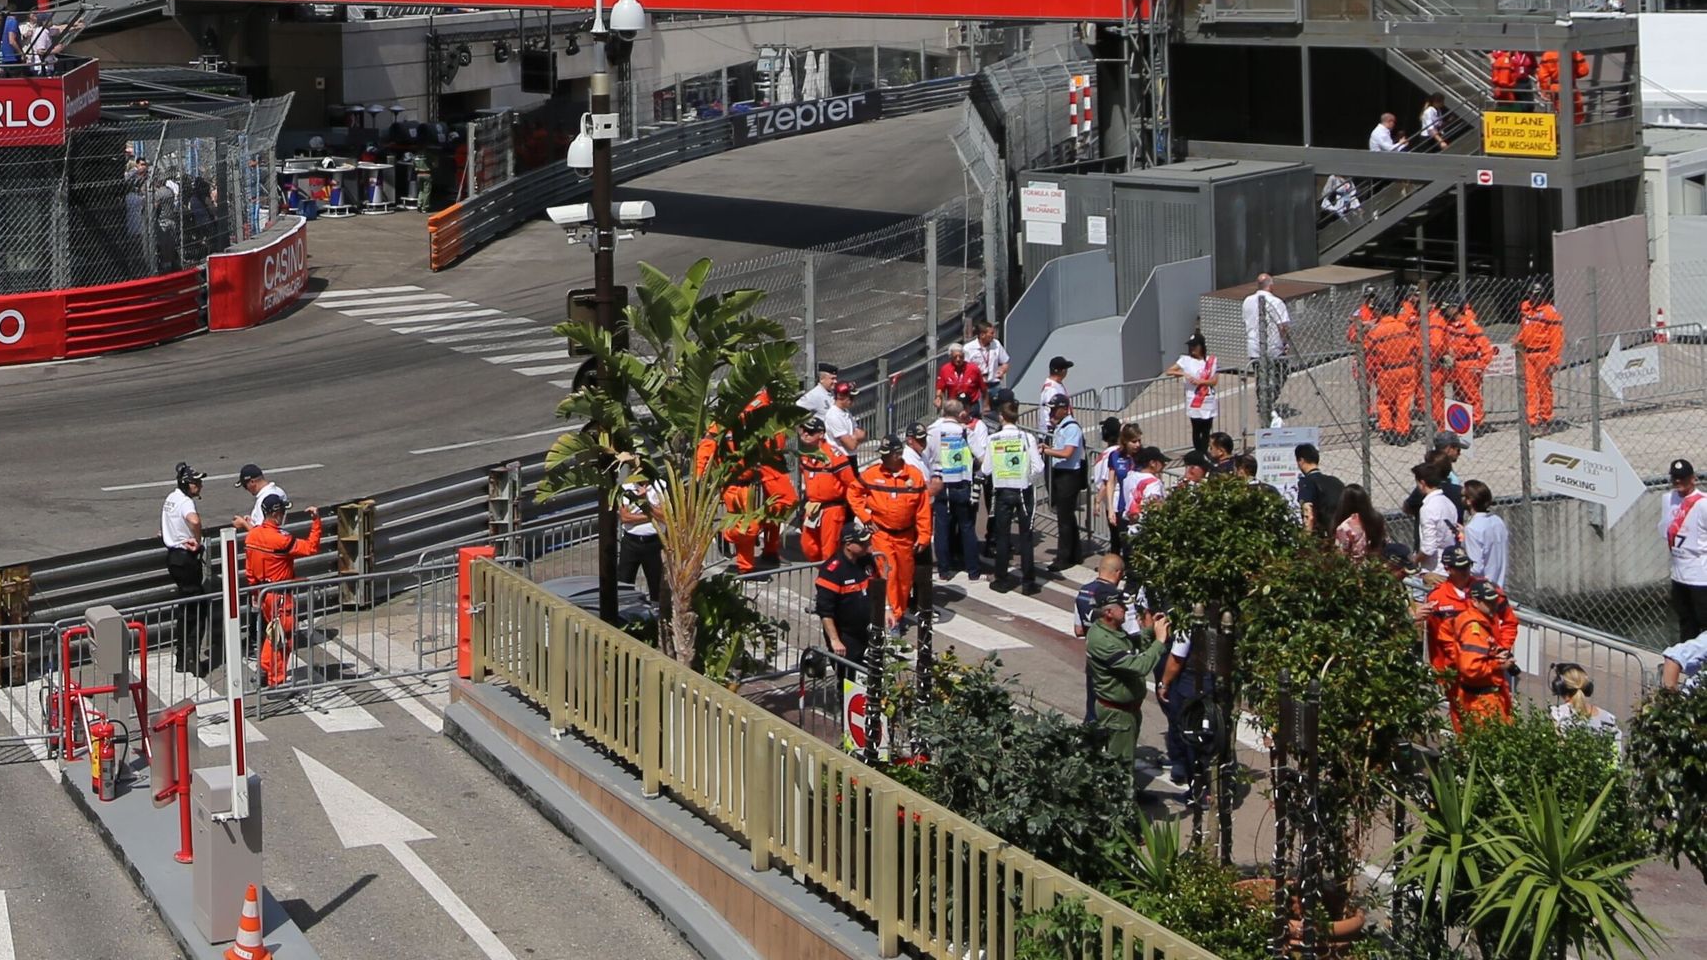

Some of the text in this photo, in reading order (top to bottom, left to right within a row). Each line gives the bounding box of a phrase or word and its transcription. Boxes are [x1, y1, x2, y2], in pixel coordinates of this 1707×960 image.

[757, 95, 866, 135] zepter
[1494, 115, 1544, 127] PIT LANE
[1491, 127, 1549, 139] RESERVED STAFF
[1489, 140, 1552, 152] AND MECHANICS
[1023, 189, 1049, 197] FORMULA
[1026, 206, 1061, 215] MECHANICS
[263, 238, 304, 290] CASINO
[1554, 474, 1597, 491] PARKING
